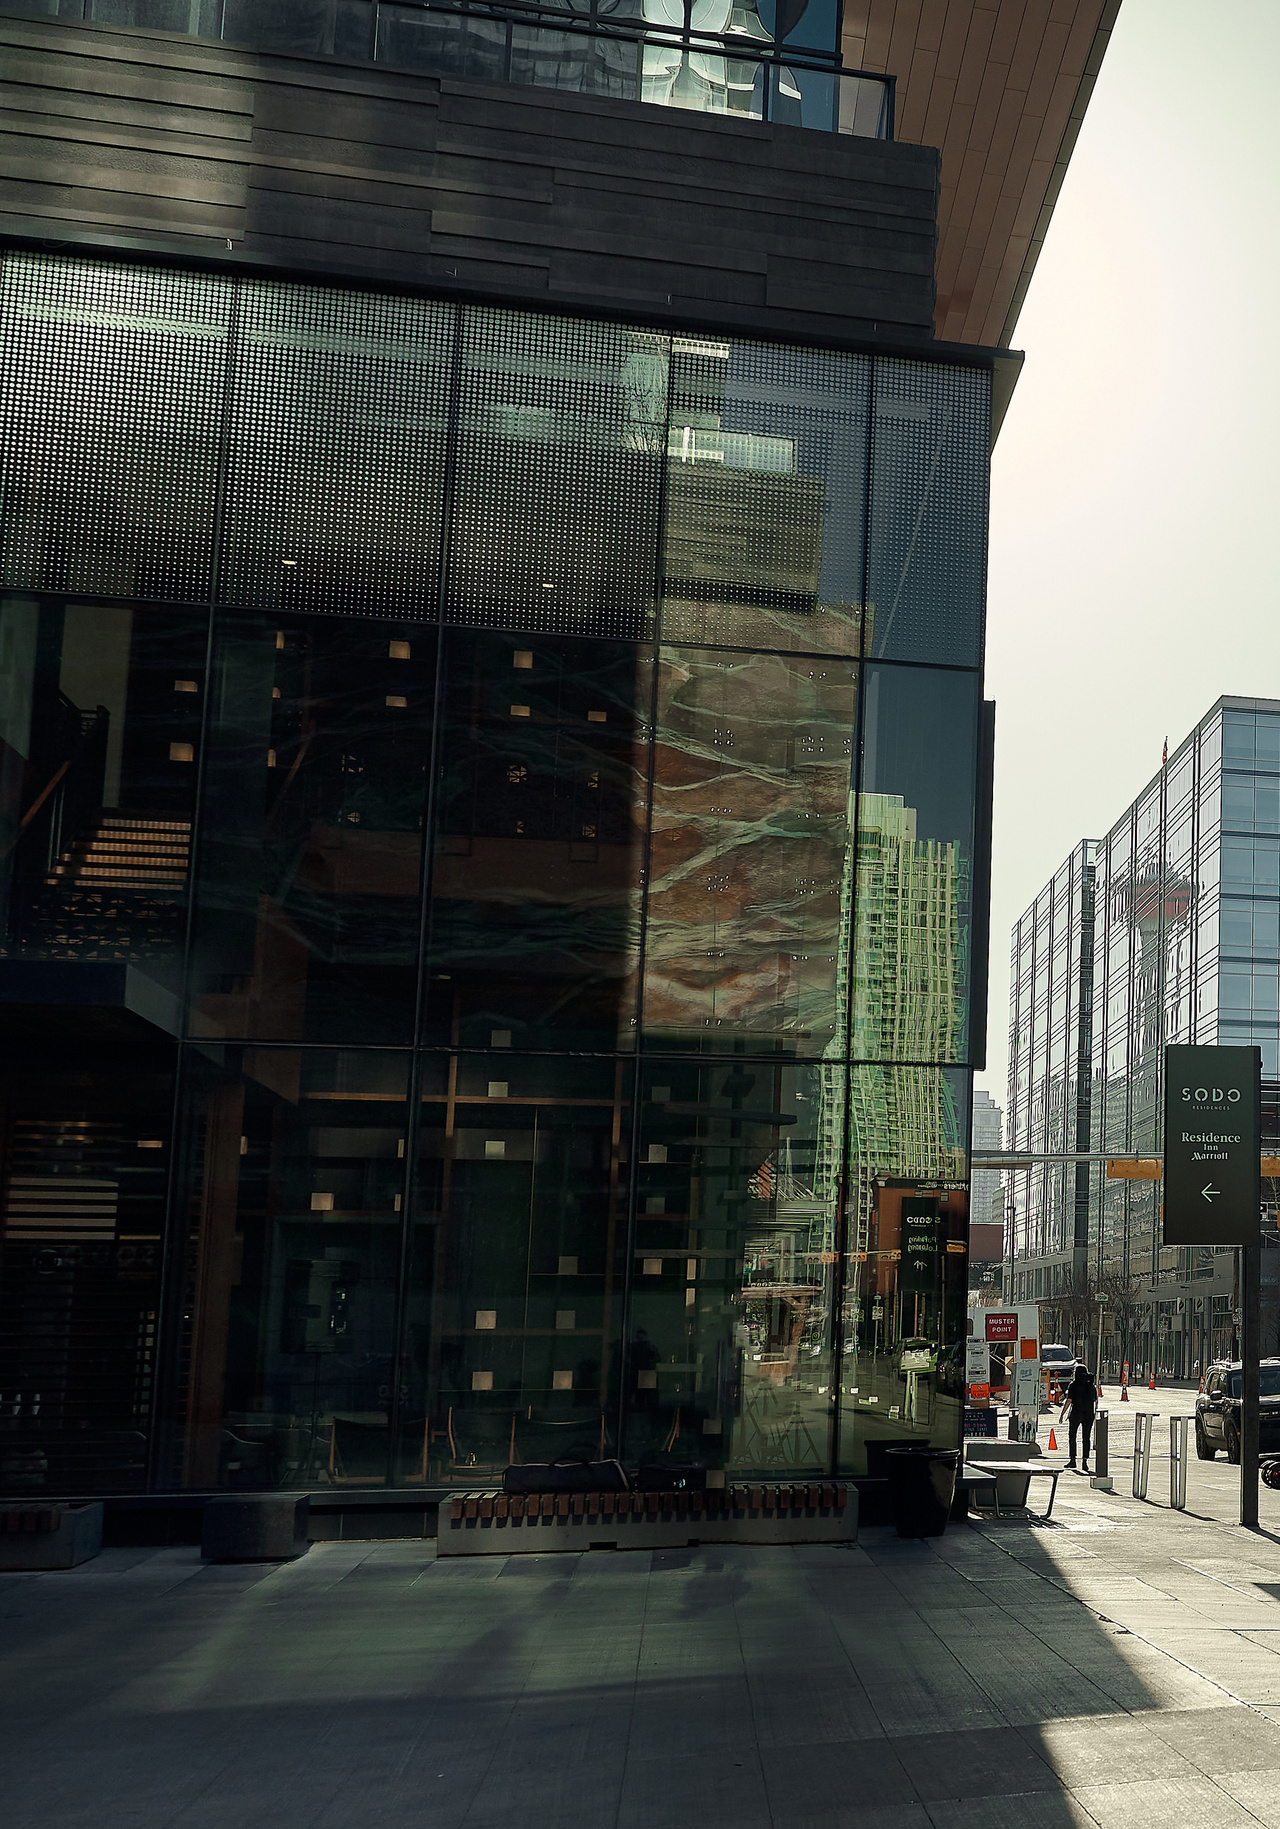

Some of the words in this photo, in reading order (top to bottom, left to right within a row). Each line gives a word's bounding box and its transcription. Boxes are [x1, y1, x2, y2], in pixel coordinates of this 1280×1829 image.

[1181, 1087, 1241, 1103] SODO
[1181, 1131, 1241, 1143] Residence
[1203, 1143, 1219, 1151] Inn
[1191, 1152, 1229, 1161] Marriott
